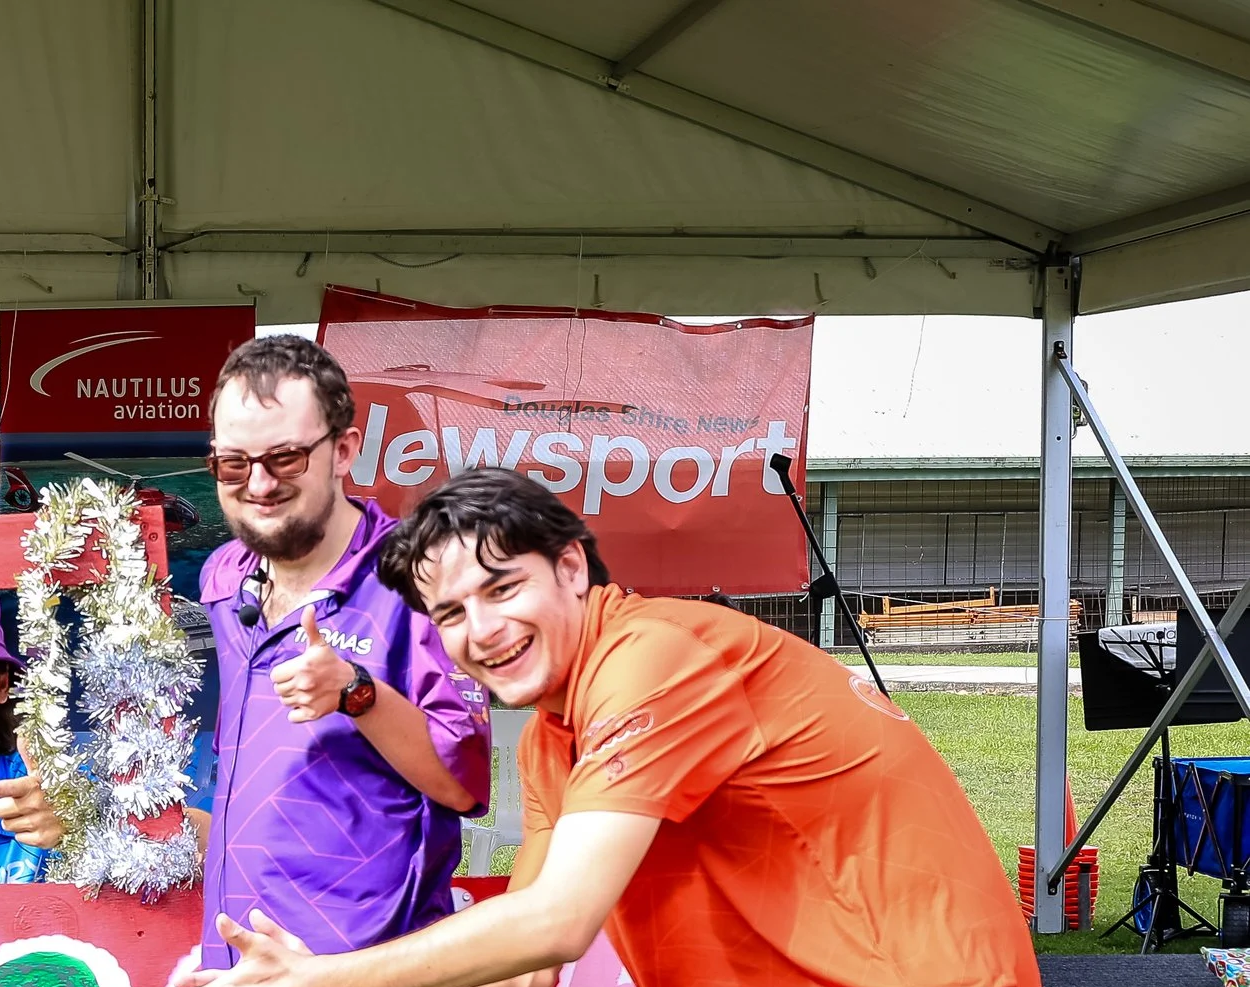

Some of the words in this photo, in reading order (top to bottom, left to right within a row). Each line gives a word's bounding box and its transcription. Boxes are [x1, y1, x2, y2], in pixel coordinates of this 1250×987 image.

[76, 377, 201, 398] NAUTILUS
[113, 400, 200, 420] aviation
[503, 395, 612, 426] Douglas
[620, 404, 691, 434] Shire
